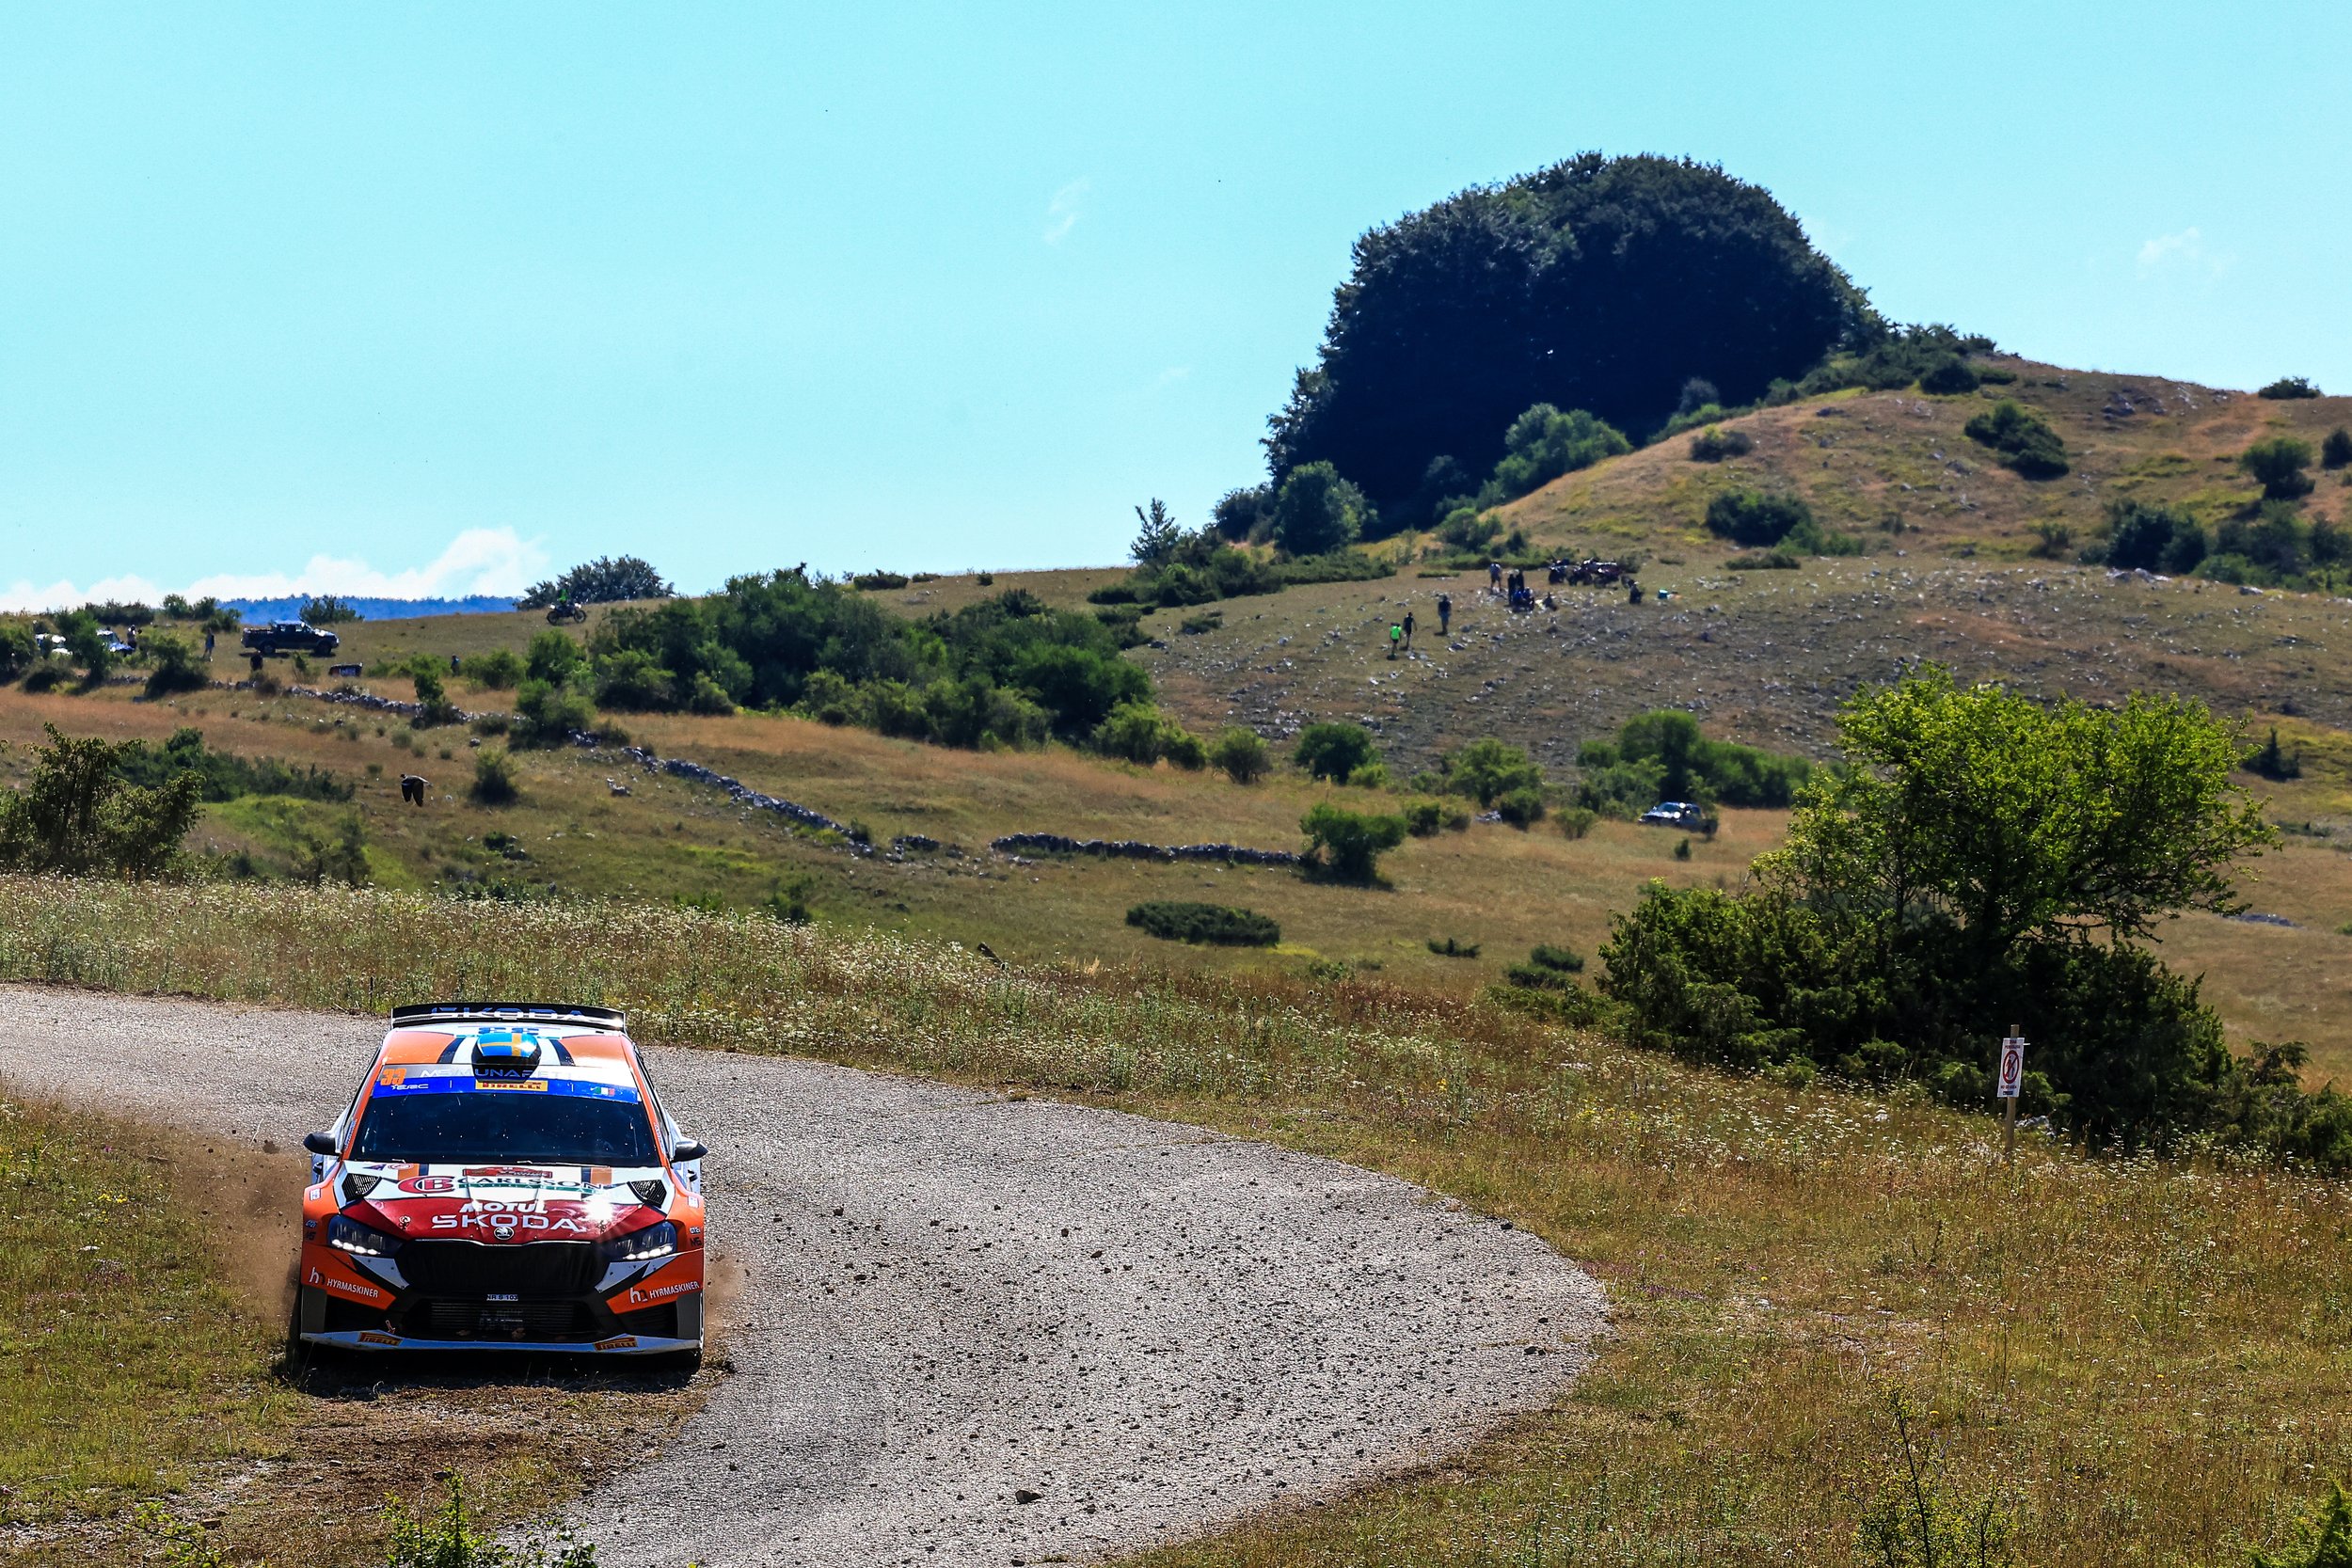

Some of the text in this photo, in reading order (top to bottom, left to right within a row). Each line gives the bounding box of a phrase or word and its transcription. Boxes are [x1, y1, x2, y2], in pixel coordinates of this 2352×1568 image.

[380, 1069, 406, 1085] 33
[457, 1177, 603, 1189] CARLSSON
[459, 1202, 548, 1213] MOTUL
[326, 1278, 379, 1298] HYRMASKINER
[649, 1280, 700, 1299] HYRMASKINER
